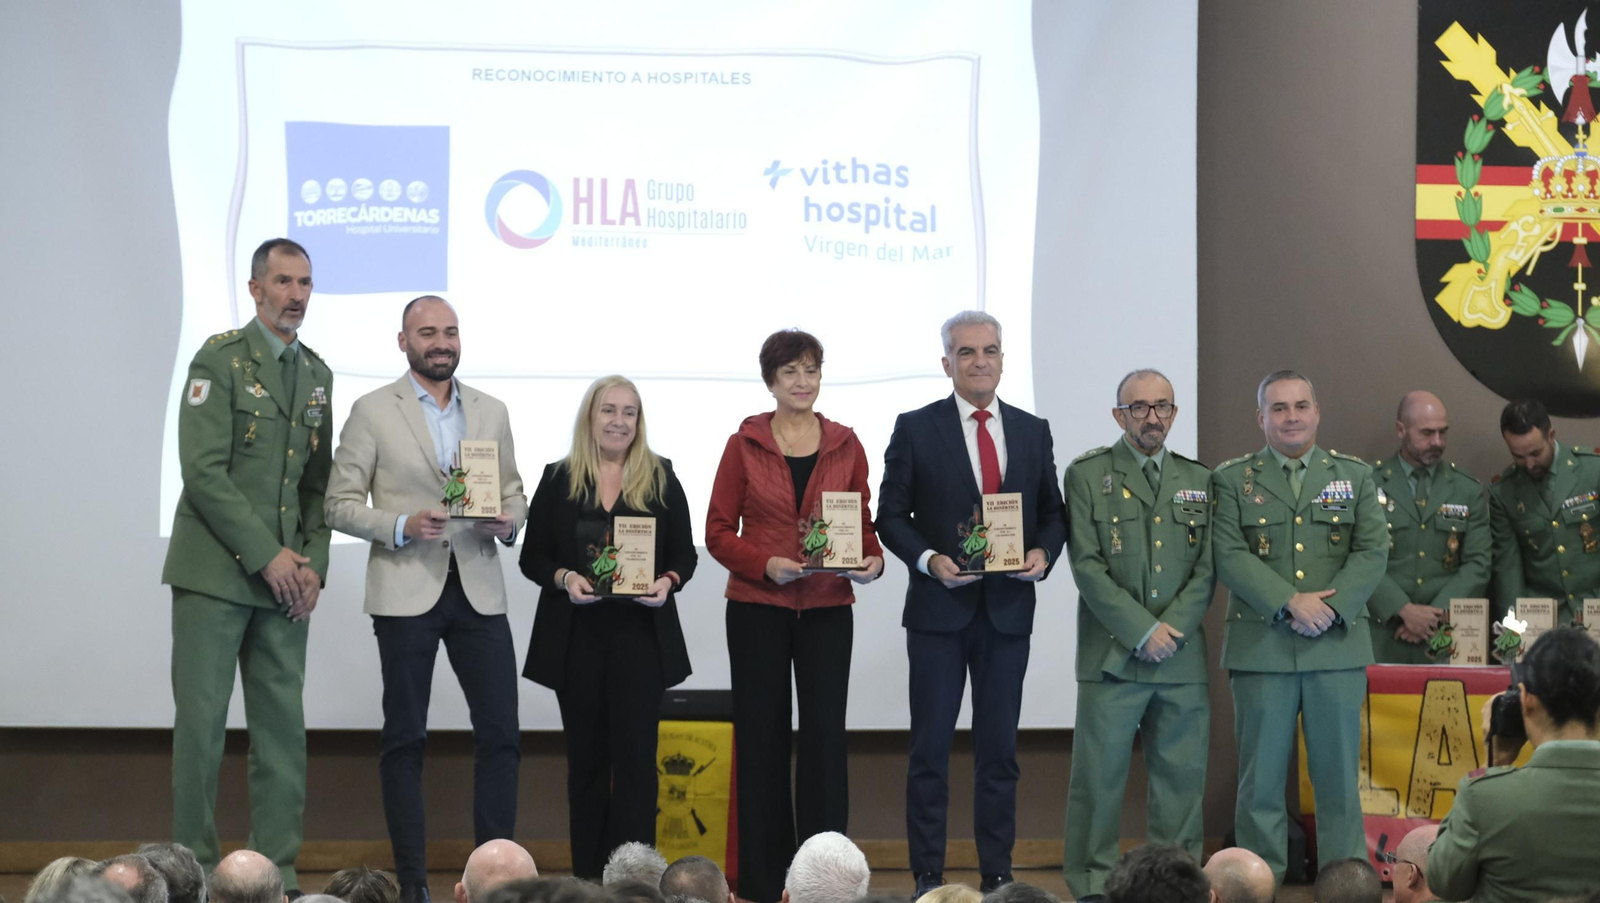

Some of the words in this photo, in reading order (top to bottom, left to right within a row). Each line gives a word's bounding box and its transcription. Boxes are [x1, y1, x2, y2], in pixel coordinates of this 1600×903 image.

[472, 67, 626, 84] RECONOCIMIENTO
[631, 71, 642, 84] A
[647, 71, 752, 86] HOSPITALES
[799, 156, 910, 189] vithas
[572, 177, 641, 227] HLA
[647, 179, 695, 204] Grupo
[294, 203, 440, 228] TORRECÁRDENAS
[647, 207, 748, 231] Hospitalario
[803, 196, 937, 234] hospital
[345, 224, 381, 236] Hospital
[382, 224, 440, 235] Universitario
[571, 235, 648, 250] Mediterráneo
[803, 235, 868, 261] Virgen
[876, 242, 904, 263] del
[912, 243, 955, 263] Mar
[481, 506, 497, 514] 2025
[841, 557, 858, 565] 2025
[1003, 558, 1020, 566] 2025
[632, 583, 649, 591] 2025
